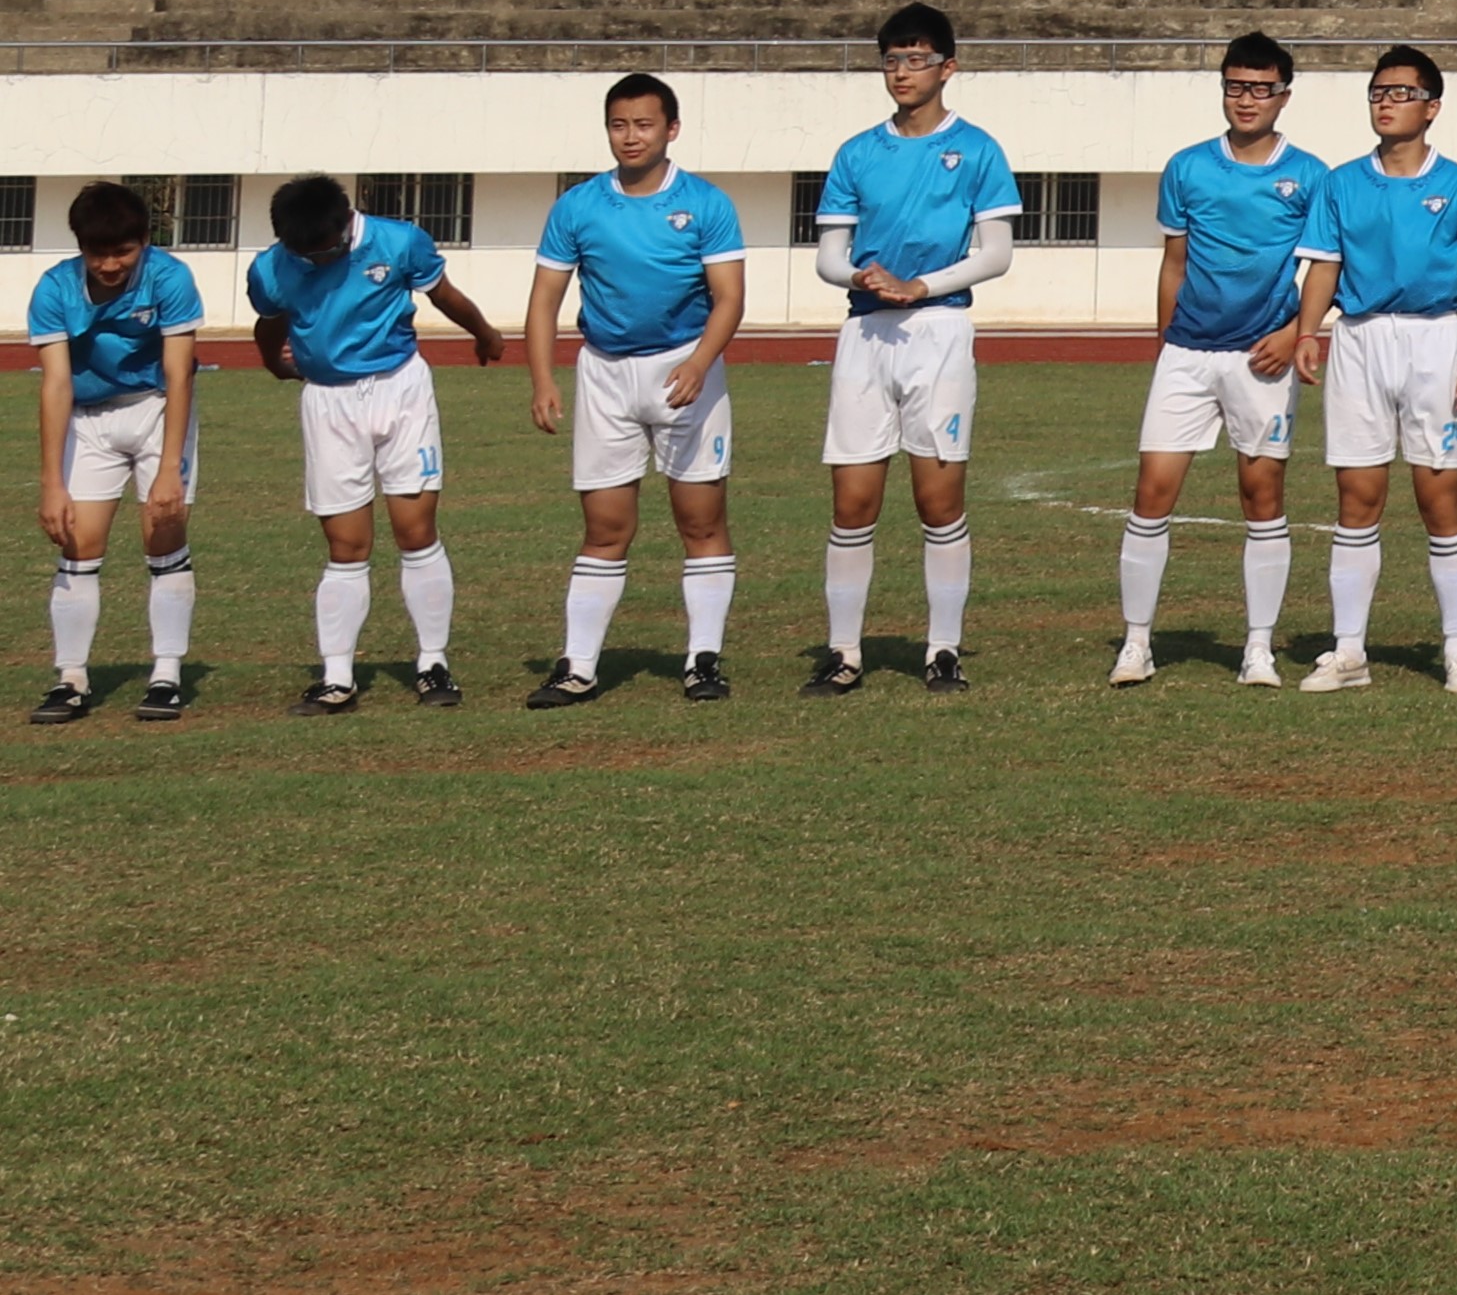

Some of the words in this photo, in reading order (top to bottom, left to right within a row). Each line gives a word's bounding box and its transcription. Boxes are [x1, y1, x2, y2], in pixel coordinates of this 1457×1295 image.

[946, 413, 961, 443] 4
[1267, 414, 1293, 443] 17
[417, 446, 440, 477] 11
[713, 436, 725, 465] 9
